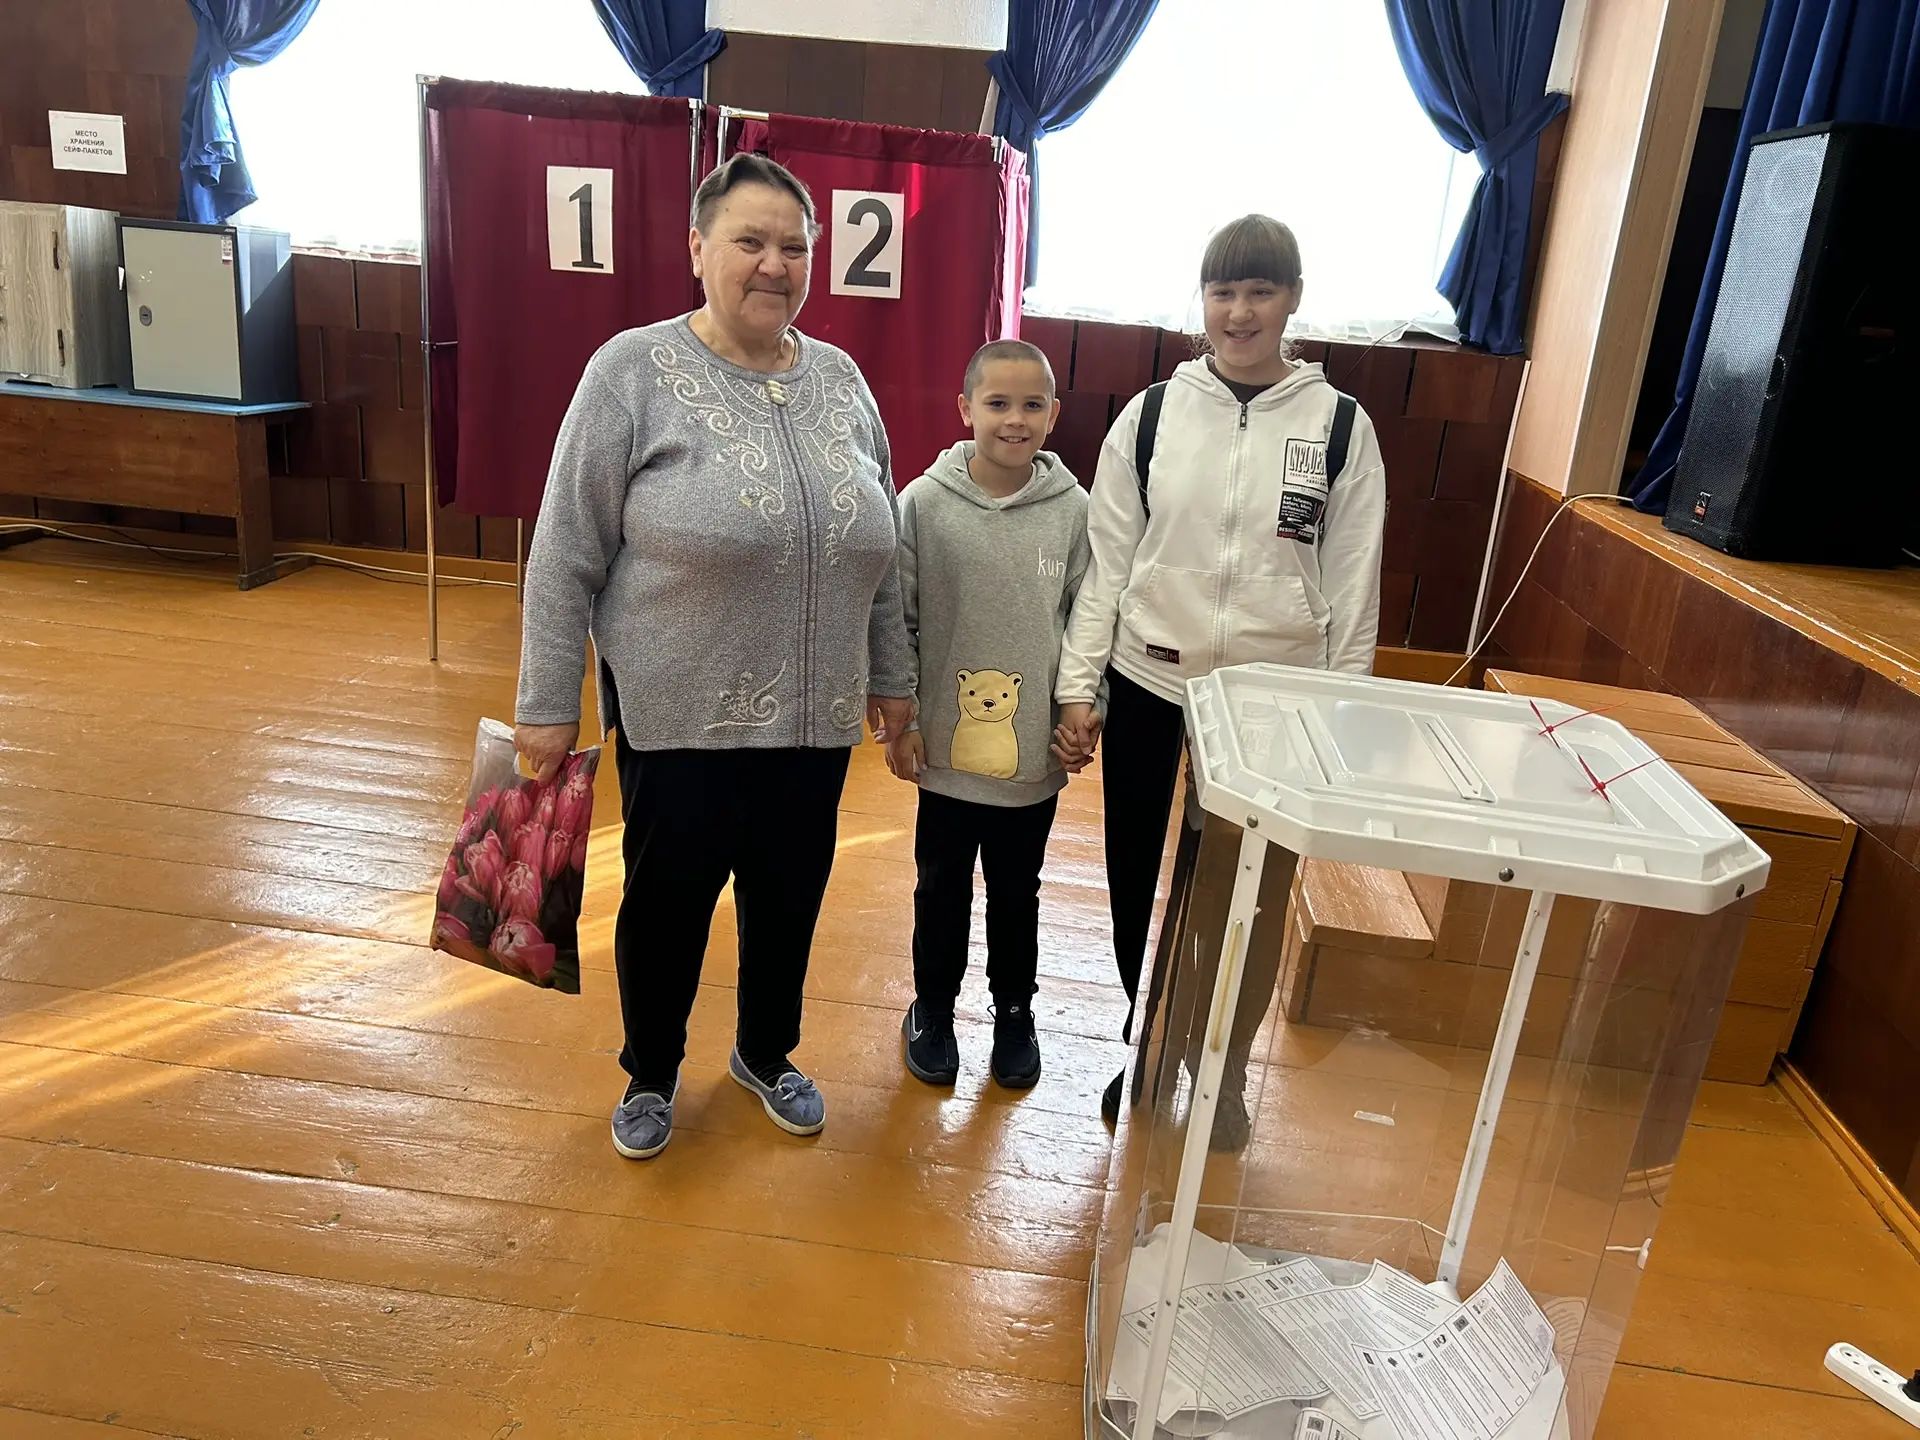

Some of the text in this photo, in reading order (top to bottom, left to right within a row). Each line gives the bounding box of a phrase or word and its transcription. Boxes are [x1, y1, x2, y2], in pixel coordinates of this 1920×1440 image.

[63, 145, 113, 156] СЕЙФ-ПАКЕТОВ
[75, 130, 97, 138] МЕСТО
[568, 183, 605, 270] 1
[843, 198, 893, 288] 2
